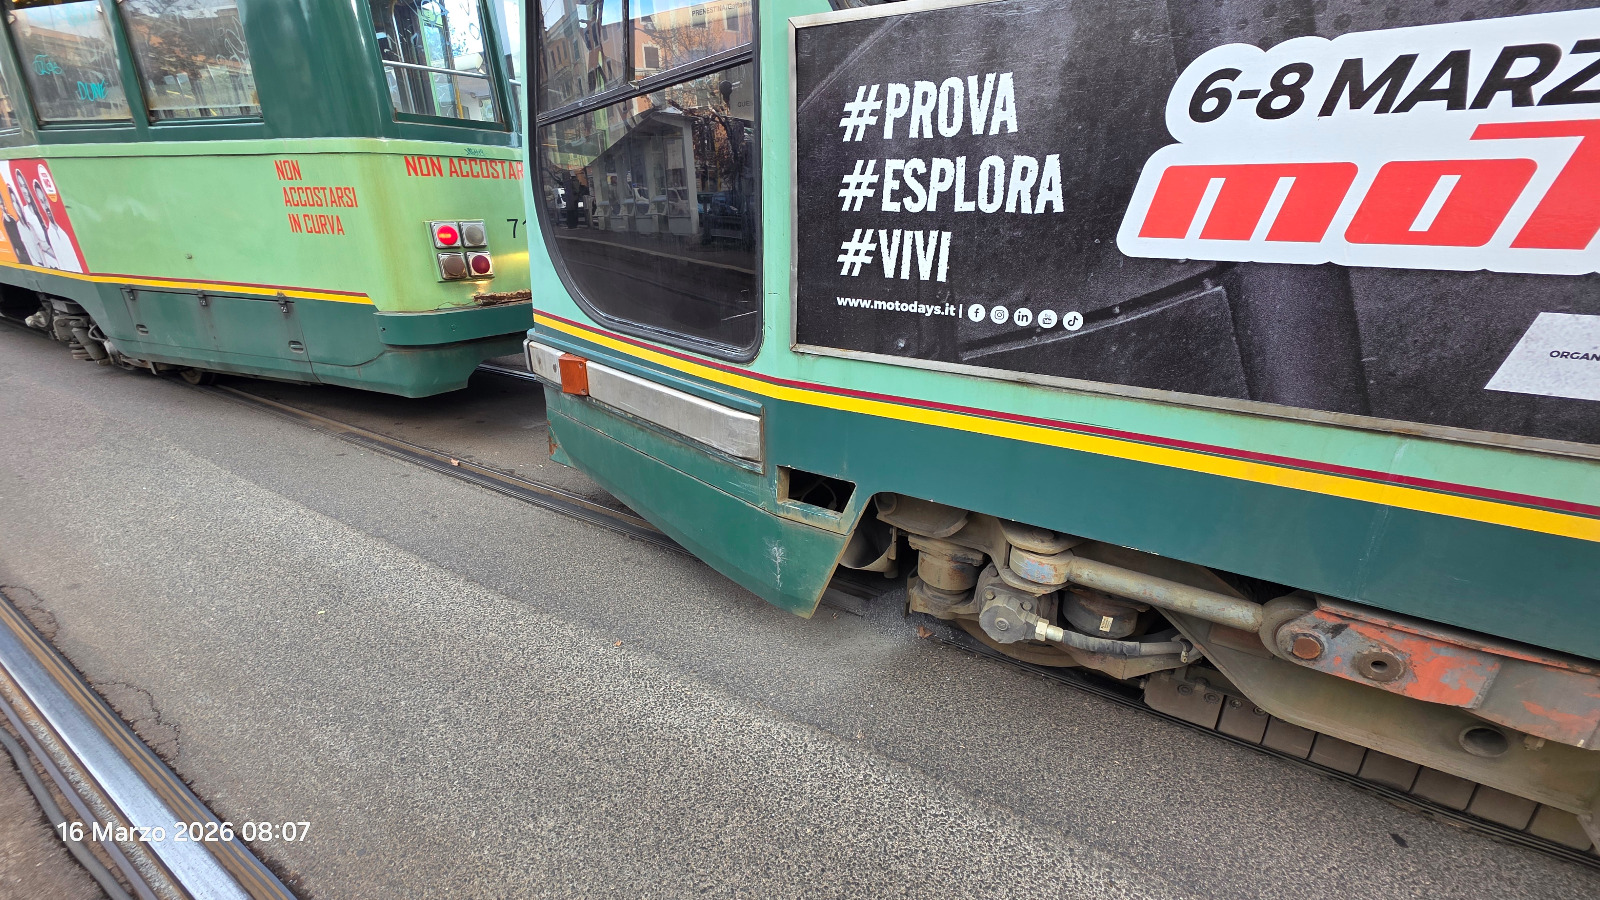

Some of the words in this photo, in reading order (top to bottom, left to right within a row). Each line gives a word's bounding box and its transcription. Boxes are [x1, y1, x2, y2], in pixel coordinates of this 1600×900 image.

[1189, 62, 1314, 123] 6-8
[839, 72, 1018, 142] #PROVA
[274, 160, 302, 181] NON
[404, 156, 443, 177] NON
[449, 157, 524, 180] ACCOSTAR
[838, 154, 1064, 214] #ESPLORA
[283, 186, 358, 208] ACCOSTARSI
[288, 213, 302, 233] IN
[303, 214, 345, 235] CURVA
[837, 228, 952, 283] #VIVI
[836, 296, 956, 317] www.motodays.it
